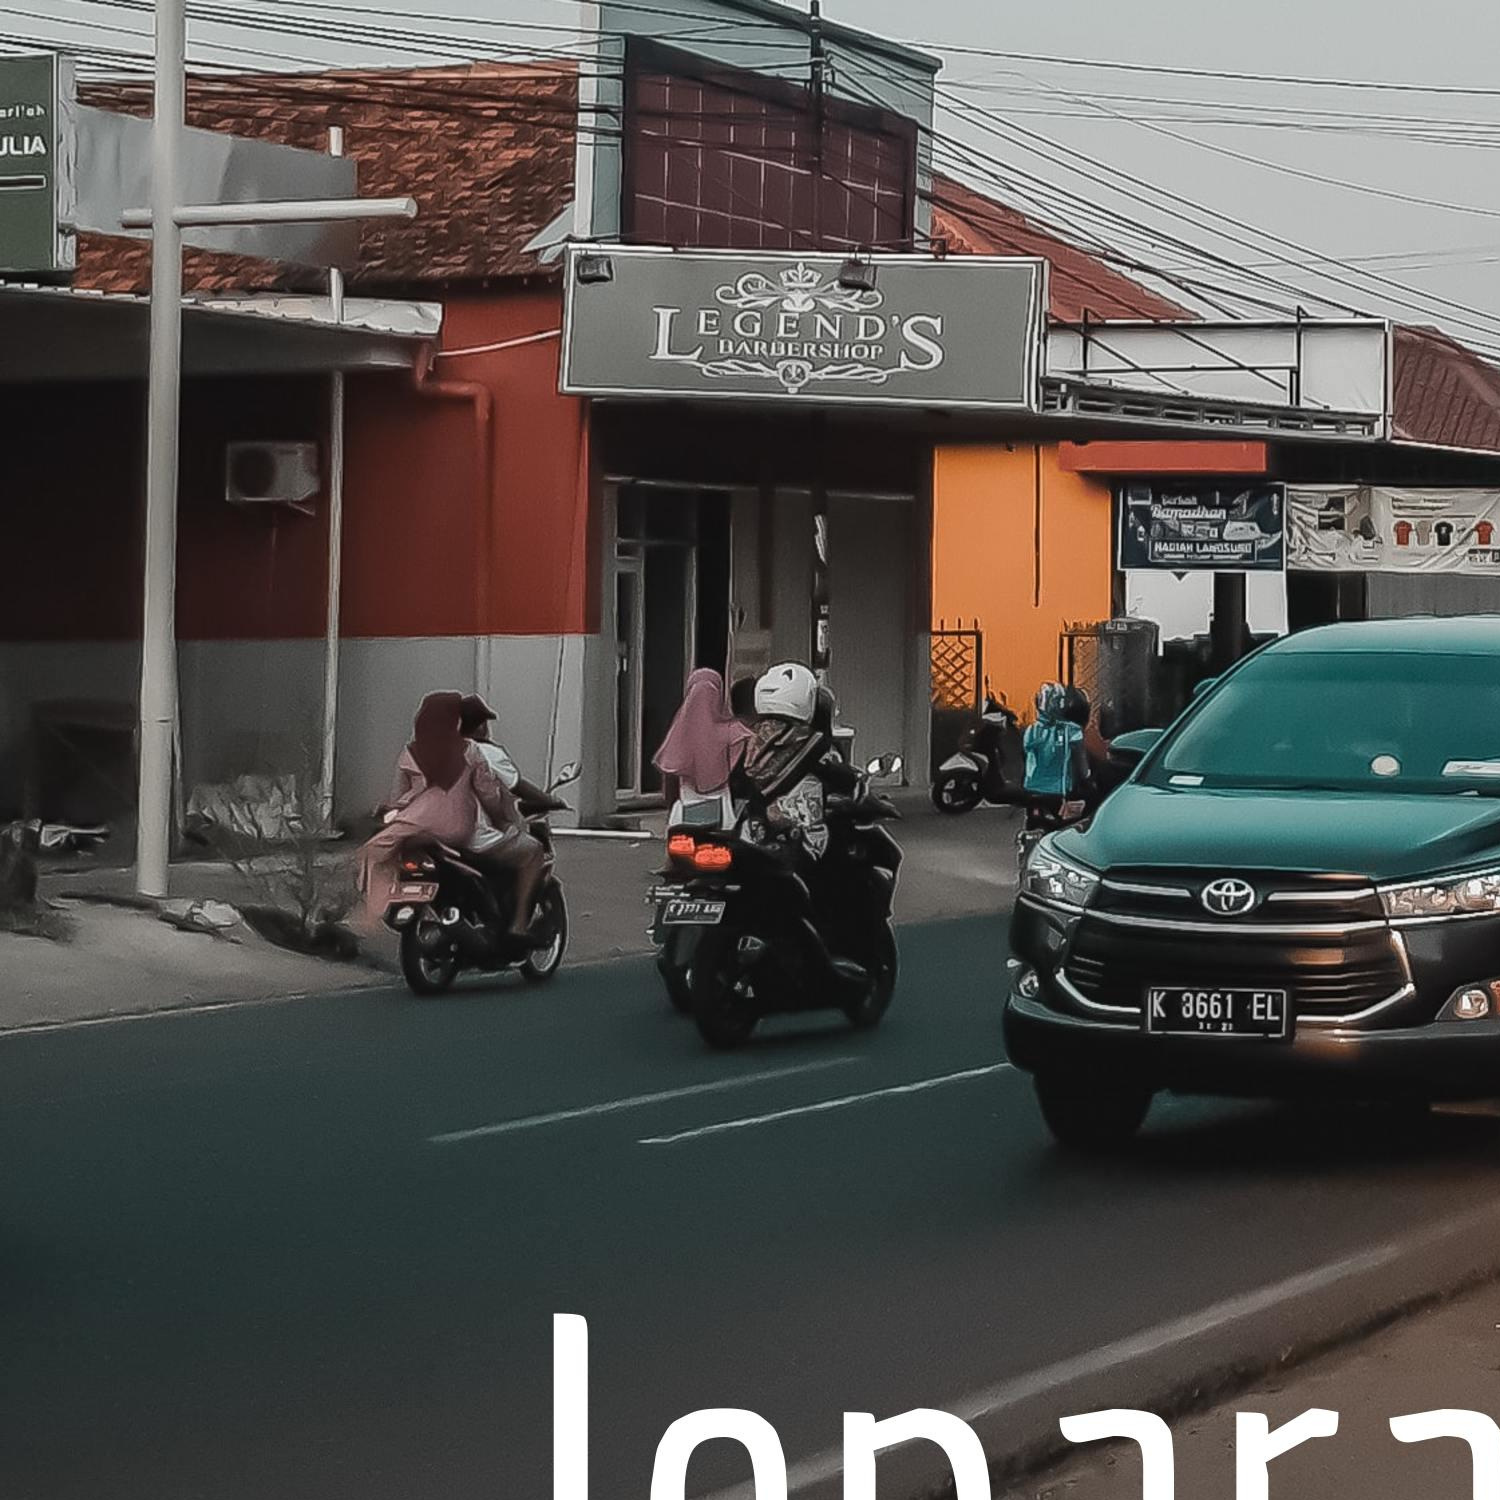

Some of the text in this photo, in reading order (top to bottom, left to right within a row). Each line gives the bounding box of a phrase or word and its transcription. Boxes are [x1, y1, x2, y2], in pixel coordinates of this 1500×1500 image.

[649, 305, 944, 370] LEGEND'S
[1151, 504, 1227, 520] Ramadhan
[1152, 991, 1167, 1018] K
[1252, 993, 1281, 1021] EL
